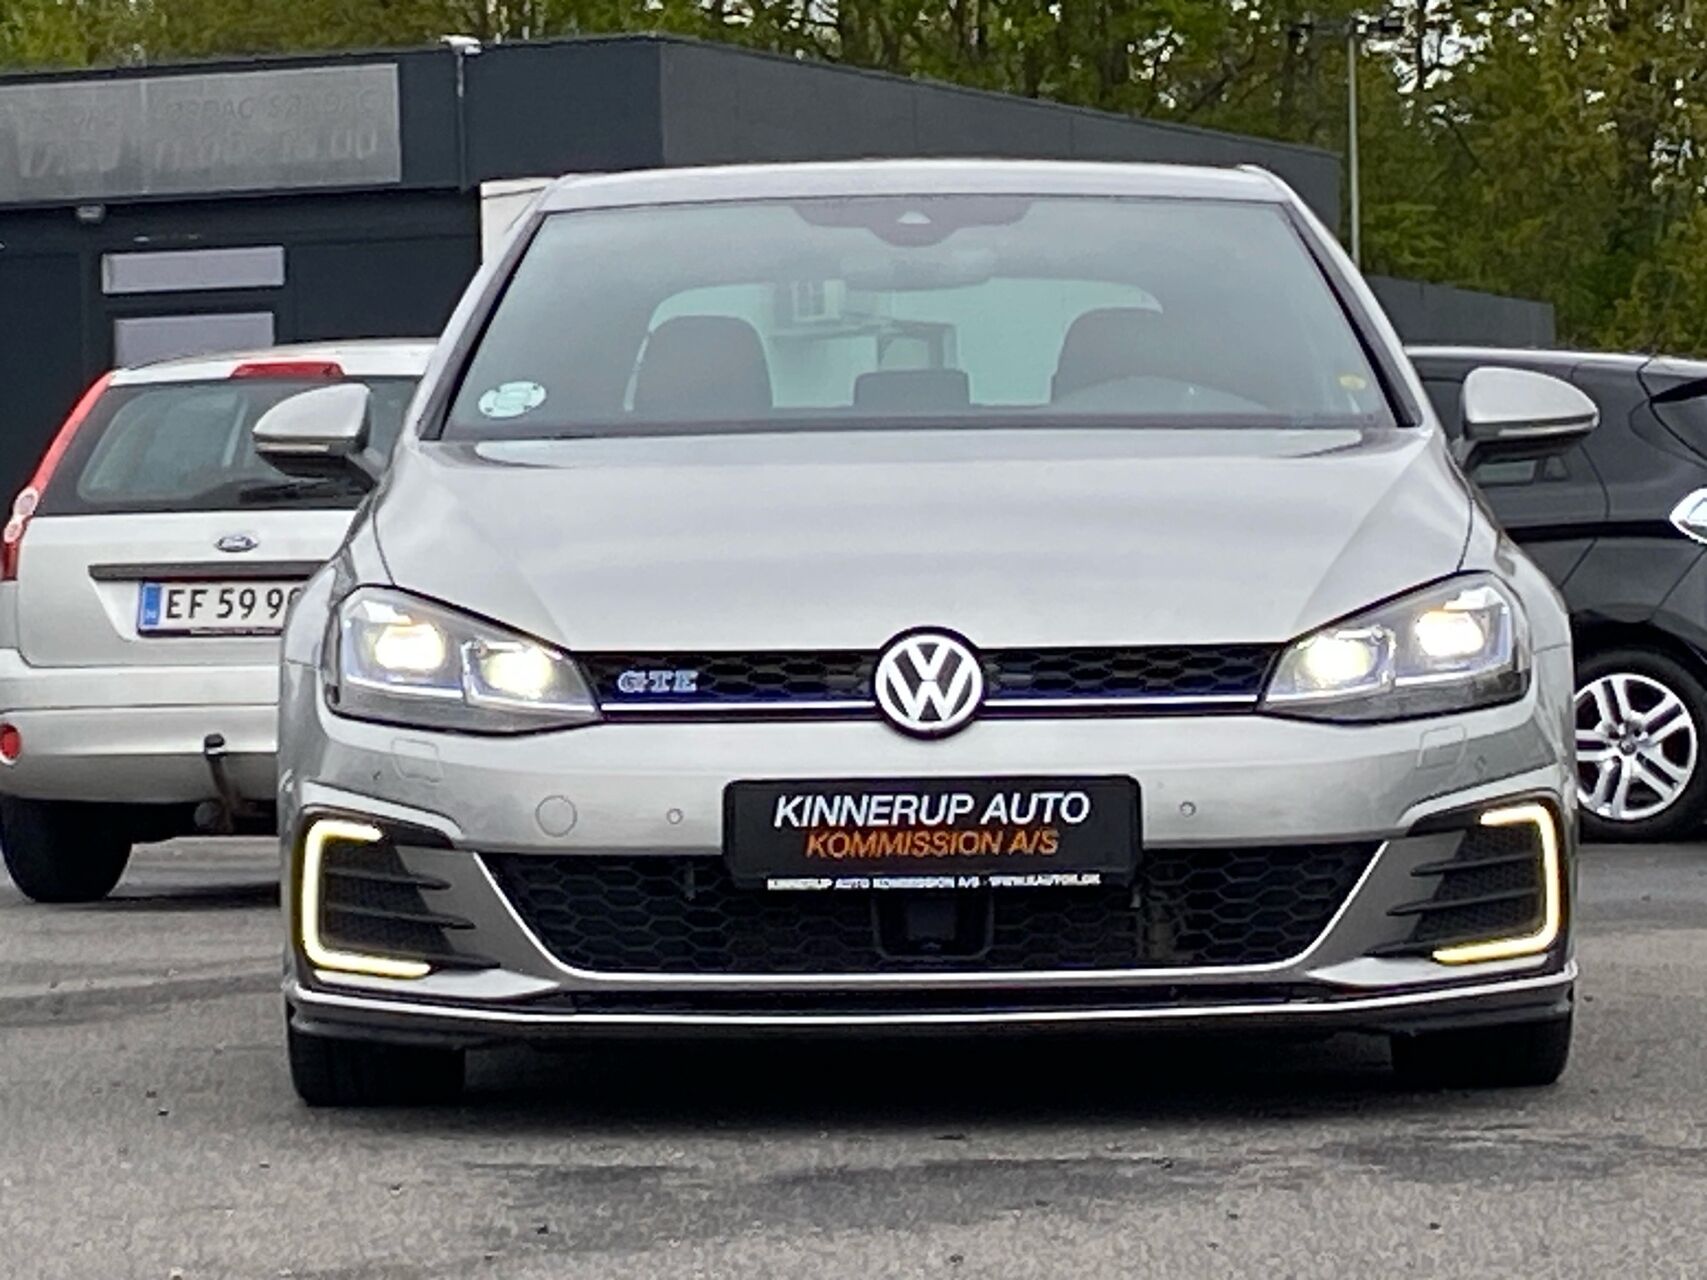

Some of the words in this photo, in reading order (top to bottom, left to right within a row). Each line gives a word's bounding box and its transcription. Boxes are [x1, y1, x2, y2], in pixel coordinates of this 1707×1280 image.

[166, 589, 208, 619] EF
[216, 587, 256, 619] 59
[617, 670, 699, 693] GTE
[773, 794, 975, 828] KINNERUP
[980, 792, 1091, 825] AUTO
[805, 829, 1003, 859] KOMMISSION
[1008, 828, 1059, 856] A/S
